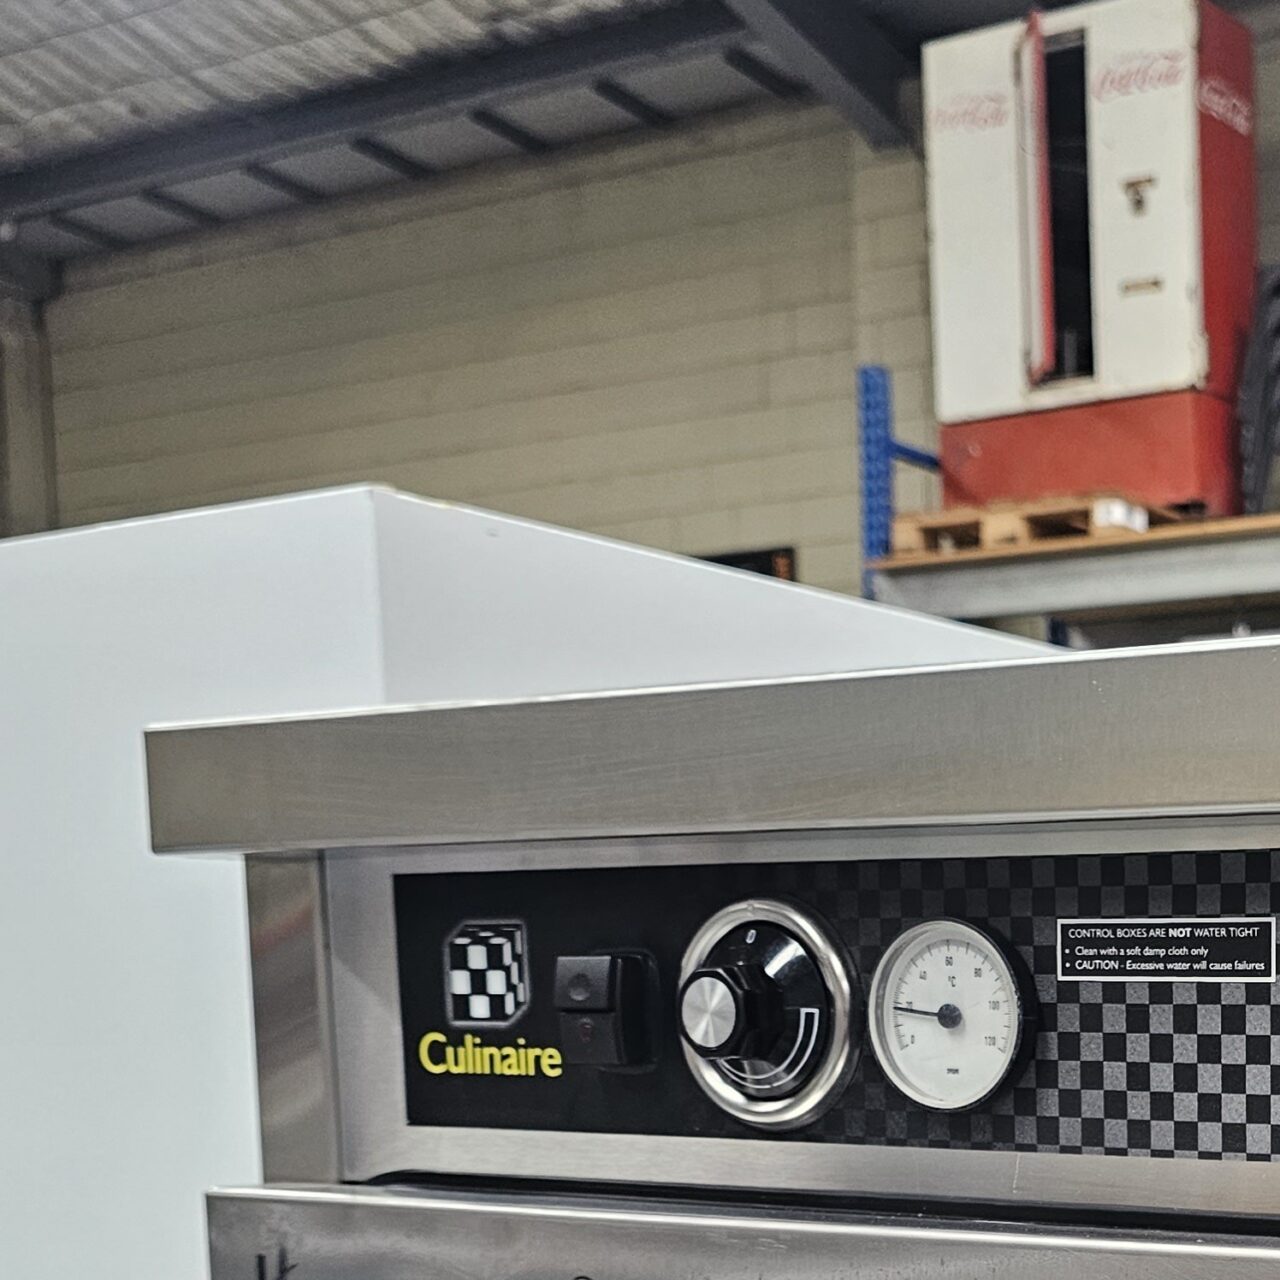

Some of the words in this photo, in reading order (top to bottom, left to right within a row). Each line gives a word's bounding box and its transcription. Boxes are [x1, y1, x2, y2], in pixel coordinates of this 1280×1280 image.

[1068, 928, 1115, 938] CONTROL
[1116, 928, 1147, 938] BOXES
[1148, 928, 1167, 938] ARE
[1168, 927, 1192, 938] NOT
[1193, 927, 1227, 937] WATER
[1228, 927, 1260, 937] TIGHT
[1075, 946, 1098, 956] Clean
[1099, 946, 1118, 956] with
[1119, 948, 1125, 956] a
[1126, 946, 1142, 956] soft
[1143, 946, 1166, 958] damp
[1167, 946, 1189, 956] cloth
[1190, 946, 1209, 958] only
[1075, 960, 1119, 970] CAUTION
[1126, 960, 1164, 970] Excessive
[1166, 961, 1191, 970] water
[1192, 960, 1207, 970] will
[1209, 962, 1233, 970] cause
[1234, 960, 1265, 970] failures
[418, 1032, 563, 1077] Culinaire
